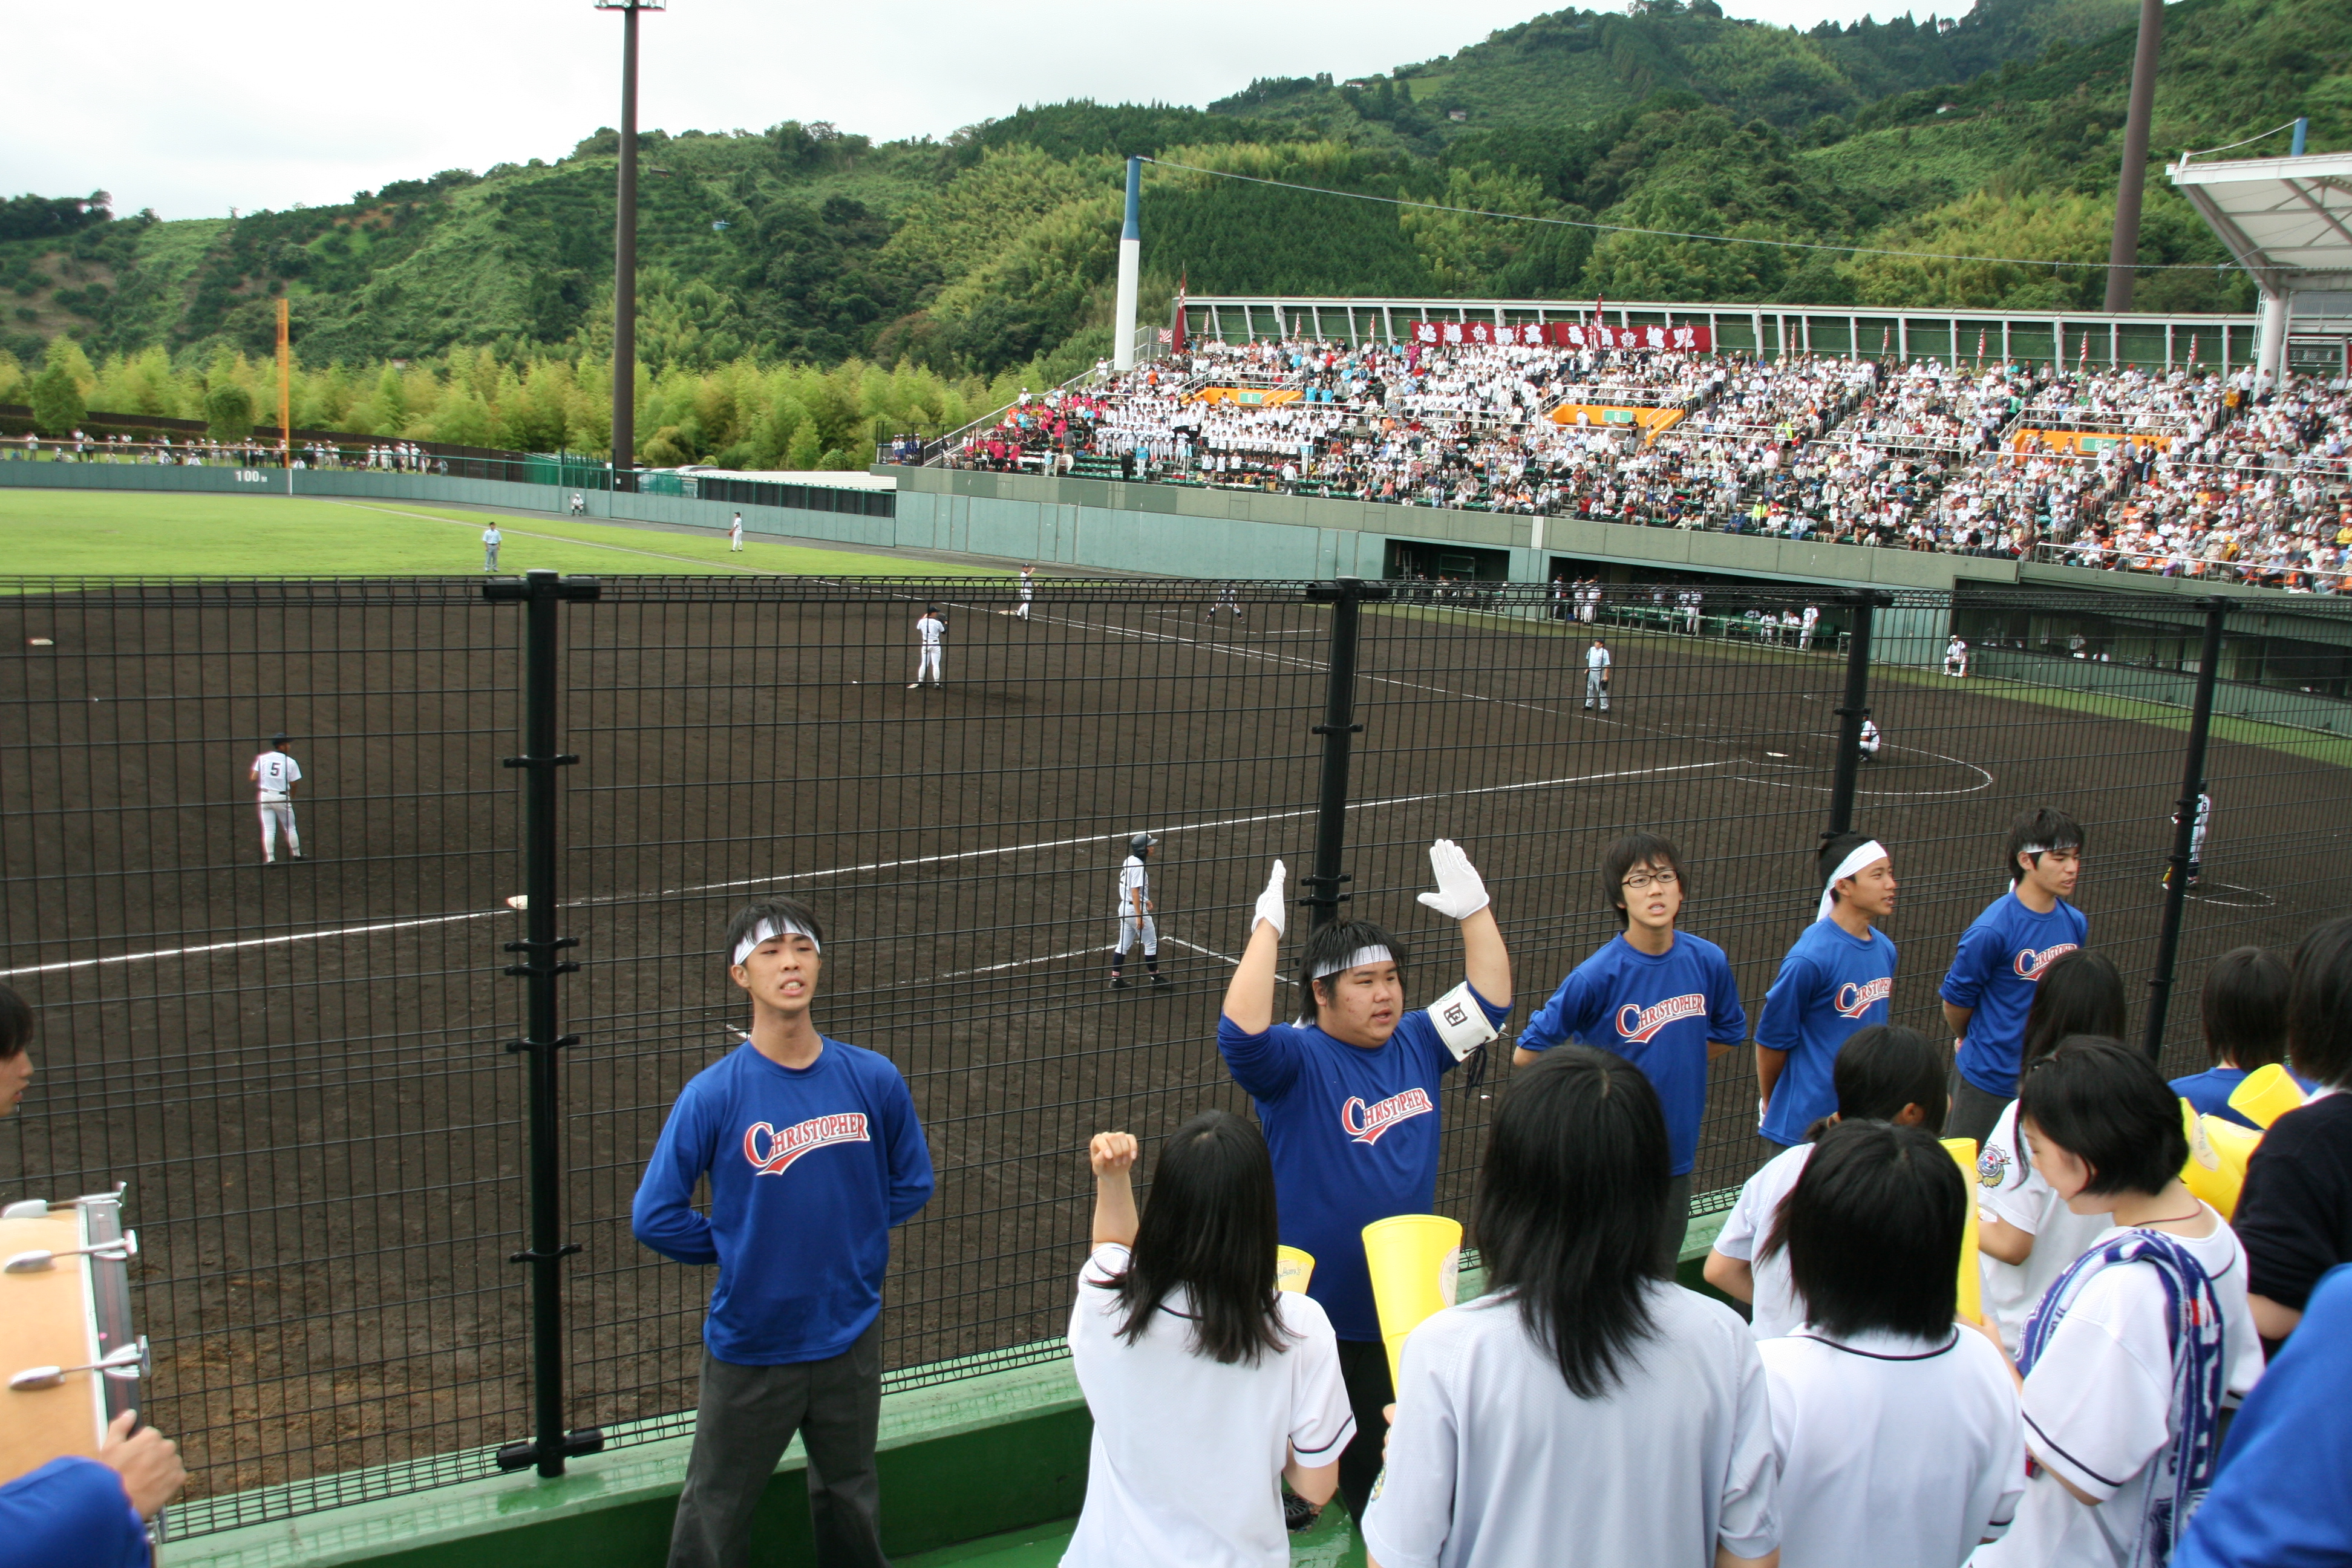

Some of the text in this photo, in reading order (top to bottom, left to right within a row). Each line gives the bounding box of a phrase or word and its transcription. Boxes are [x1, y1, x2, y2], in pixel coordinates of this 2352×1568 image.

[270, 762, 281, 776] 5
[2013, 943, 2077, 976] CHRISTO
[1834, 977, 1892, 1013] CHRSTOPH
[1615, 993, 1707, 1037] CHRISTOPHER
[745, 1112, 871, 1168] CHRISTOPHER
